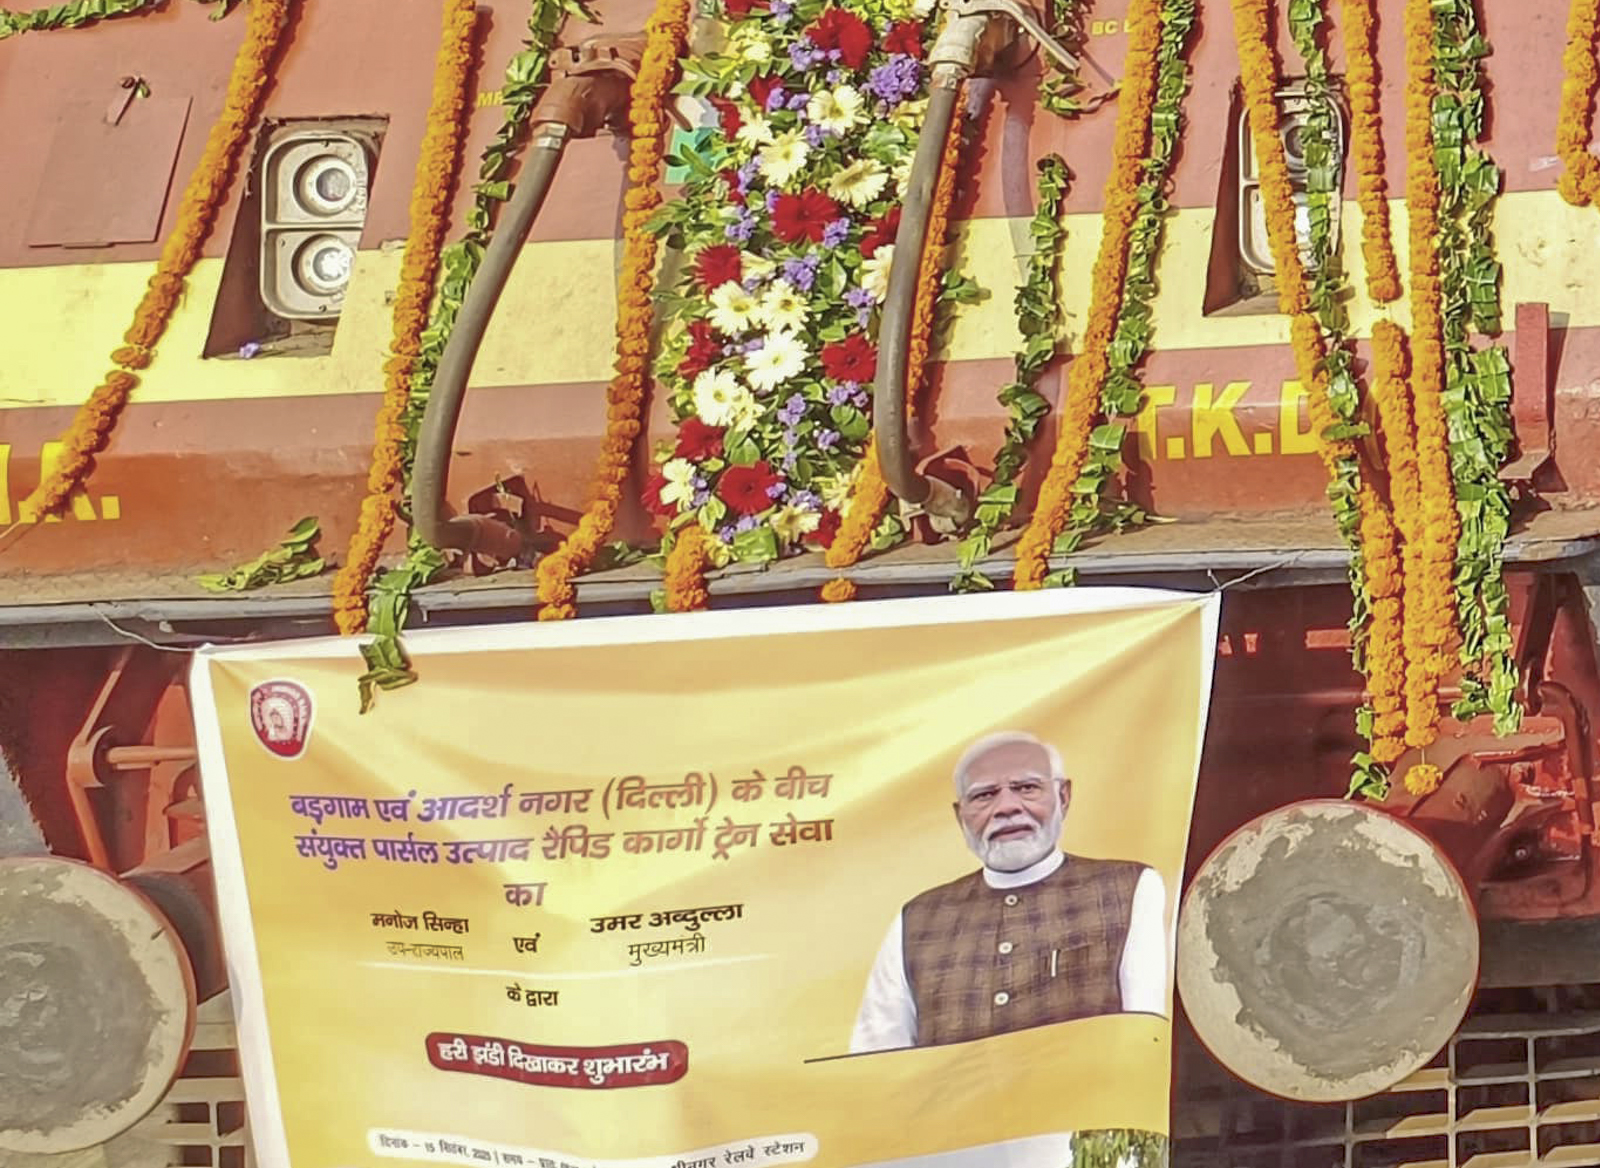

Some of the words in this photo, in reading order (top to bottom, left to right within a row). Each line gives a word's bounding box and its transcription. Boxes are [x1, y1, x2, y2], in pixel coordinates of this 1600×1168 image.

[373, 789, 417, 822] एवं
[417, 783, 514, 822] आदर्श
[518, 788, 594, 816] नगर
[601, 772, 718, 820] (दिल्ली)
[731, 770, 767, 802] के
[294, 828, 367, 870] संयुक्त
[372, 832, 439, 863] पार्सल
[442, 838, 534, 864] उत्पाद
[541, 824, 615, 860] रैपिड
[622, 816, 709, 854] कार्गो
[711, 816, 762, 861] ट्रेन
[769, 812, 835, 846] सेवा
[503, 882, 548, 907] का
[370, 910, 418, 931] मनोज
[423, 911, 469, 934] सिन्हा
[590, 914, 644, 933] उमर
[513, 932, 541, 953] एवं
[506, 983, 522, 1002] के
[525, 990, 559, 1007] द्वारा
[437, 1038, 468, 1061] हरी
[471, 1042, 505, 1066] झंडी
[508, 1045, 580, 1075] दिखाकर
[583, 1048, 670, 1085] शुभारंभ
[723, 1145, 755, 1164] रेलवे
[762, 1141, 806, 1156] स्टेशन
